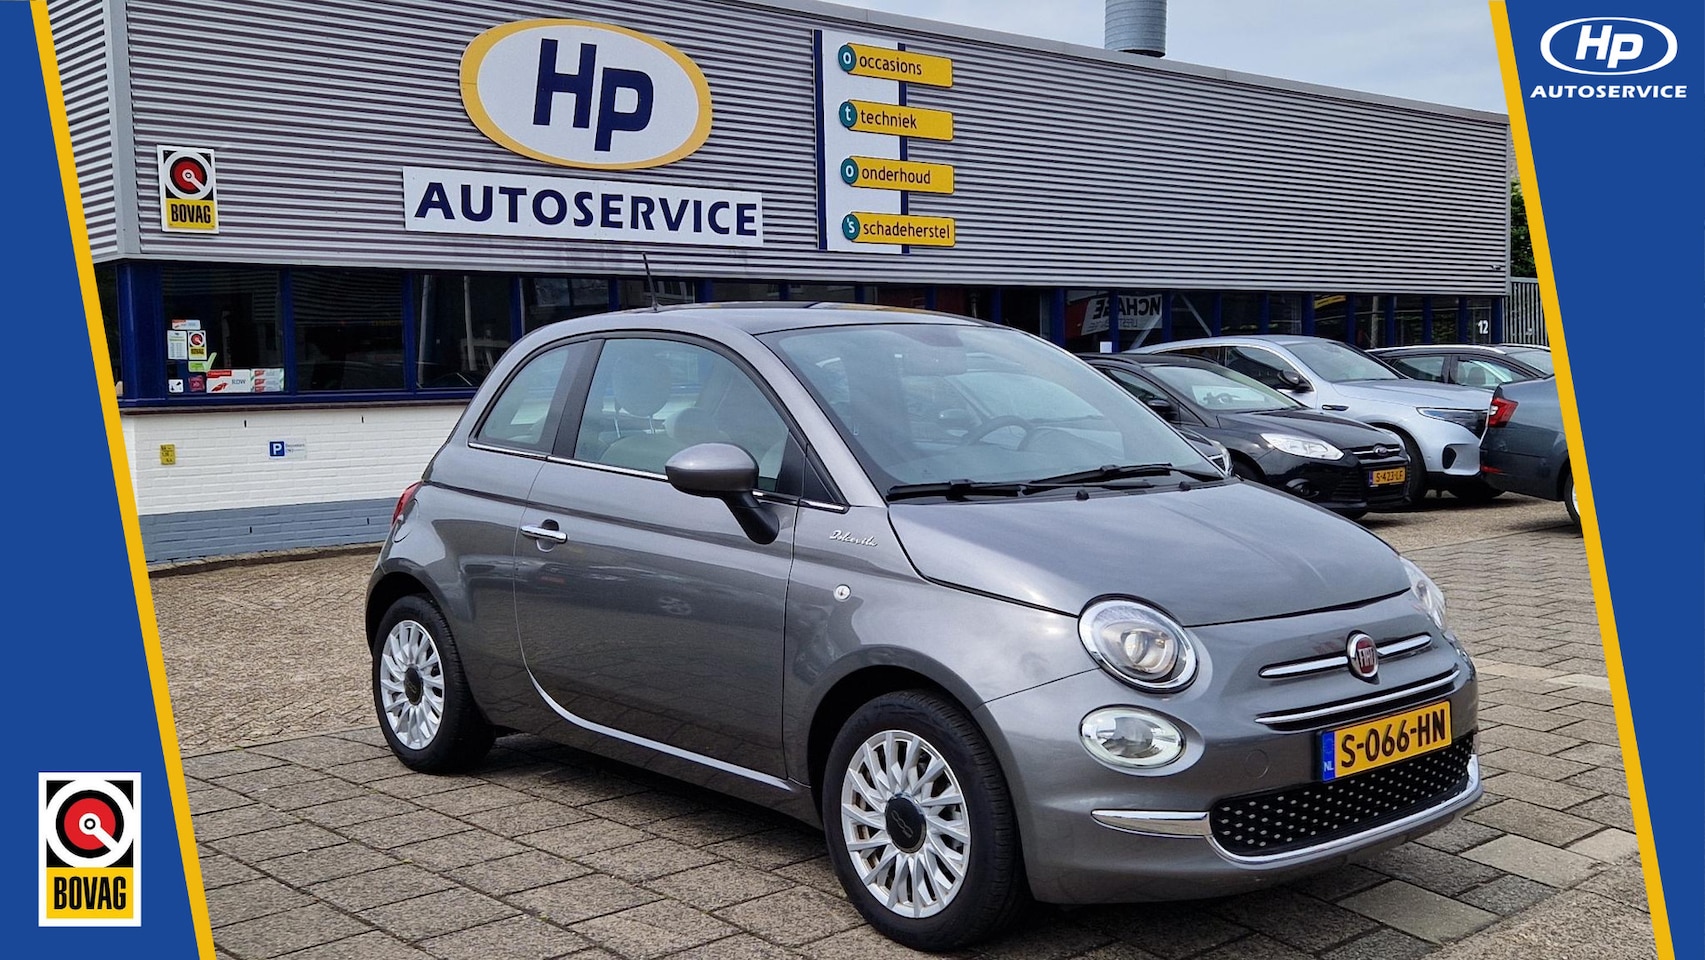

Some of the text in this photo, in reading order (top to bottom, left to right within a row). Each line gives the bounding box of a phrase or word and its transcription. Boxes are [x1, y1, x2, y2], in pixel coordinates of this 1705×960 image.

[843, 52, 922, 76] o occasions
[844, 106, 918, 129] t techniek
[845, 165, 931, 185] o onderhoud
[170, 203, 211, 224] BOVAG
[414, 181, 758, 237] AUTOSERVICE
[863, 220, 950, 239] schadeherstel
[1477, 319, 1489, 335] 12
[273, 443, 283, 455] P
[1358, 646, 1375, 668] FIAT
[1341, 709, 1446, 769] S-066-HN
[1323, 761, 1335, 772] NL
